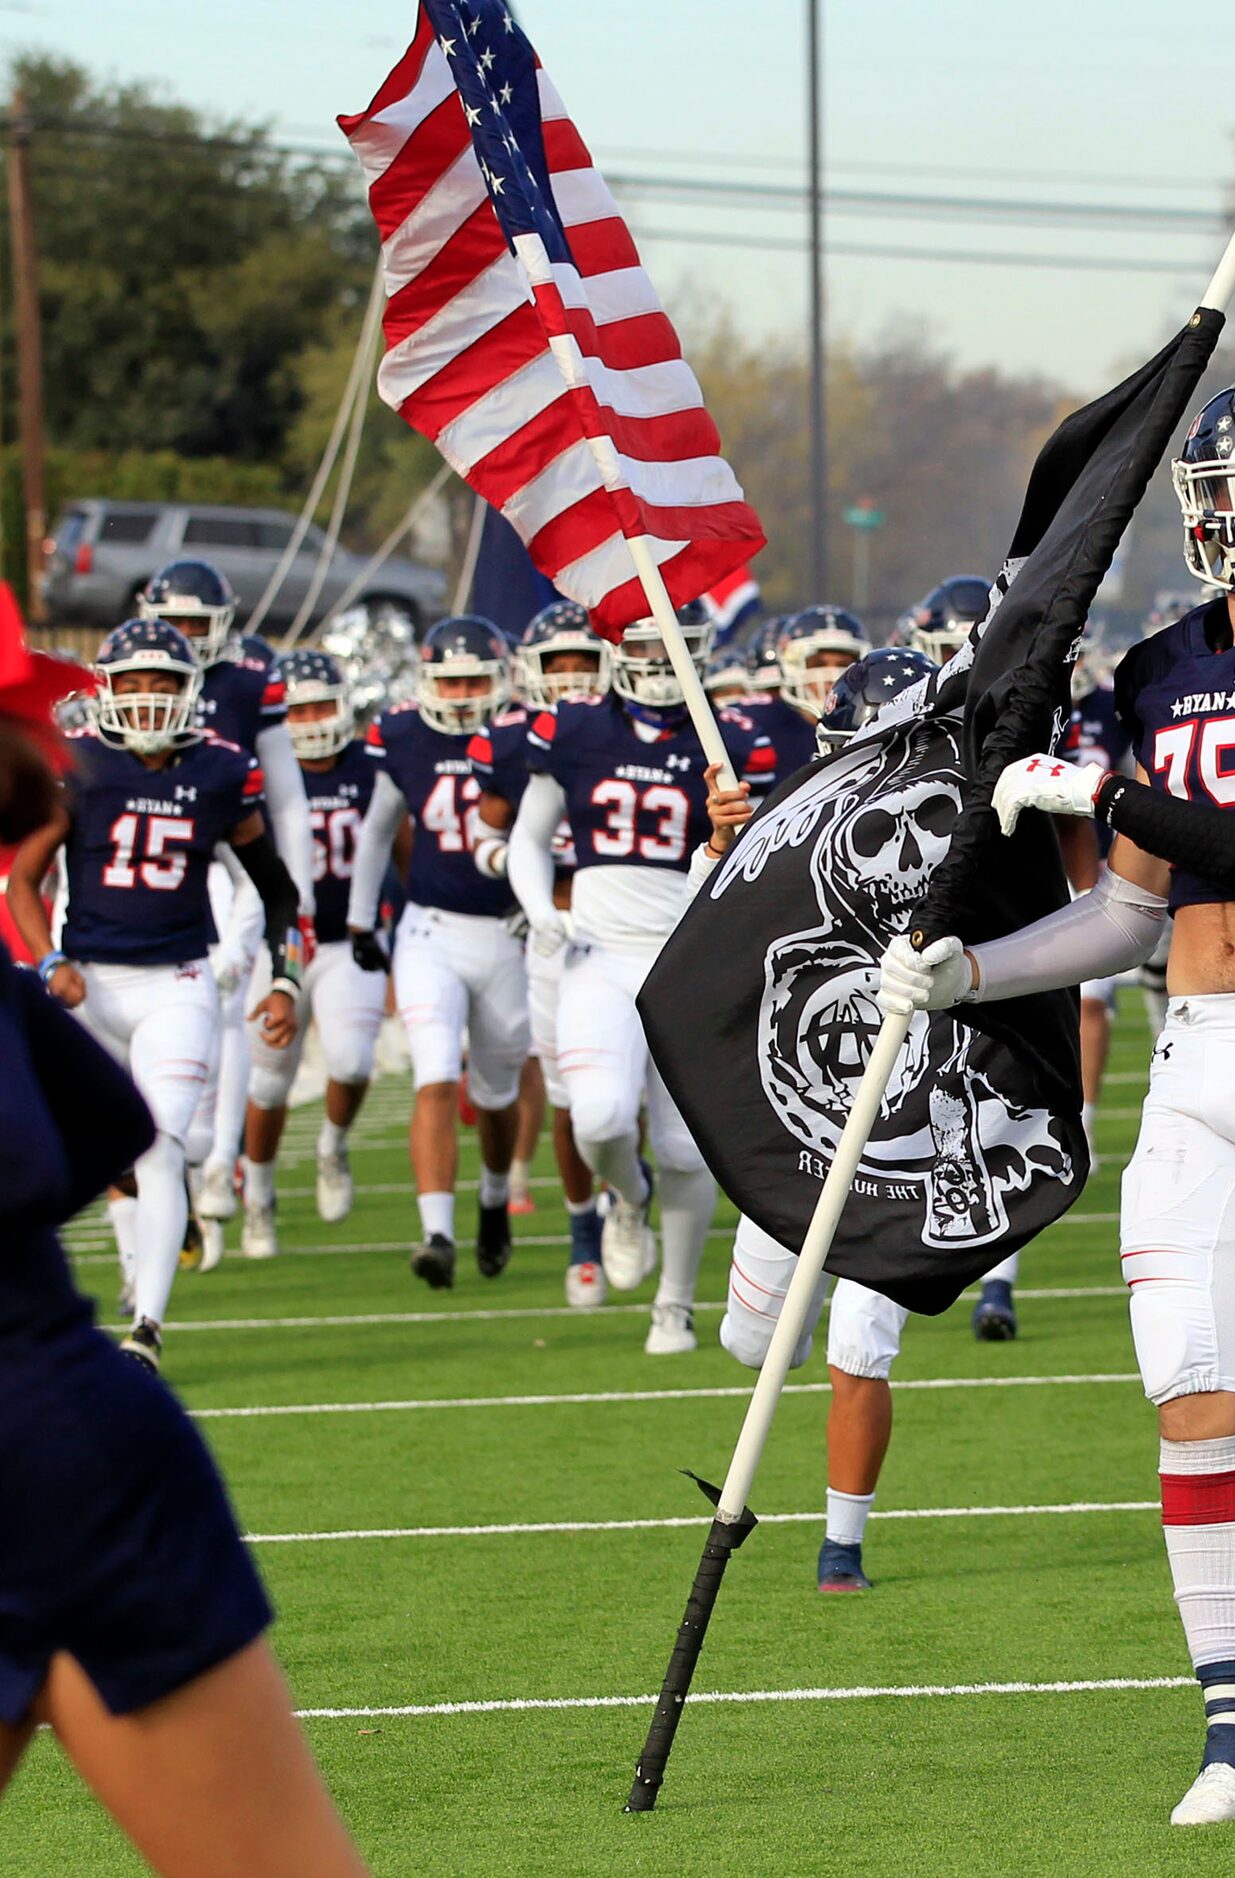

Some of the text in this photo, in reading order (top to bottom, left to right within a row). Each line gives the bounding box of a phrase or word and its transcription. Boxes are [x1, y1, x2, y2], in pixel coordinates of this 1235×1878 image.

[1183, 692, 1227, 717] RYAN
[102, 811, 196, 891] 15
[591, 778, 688, 861] 33
